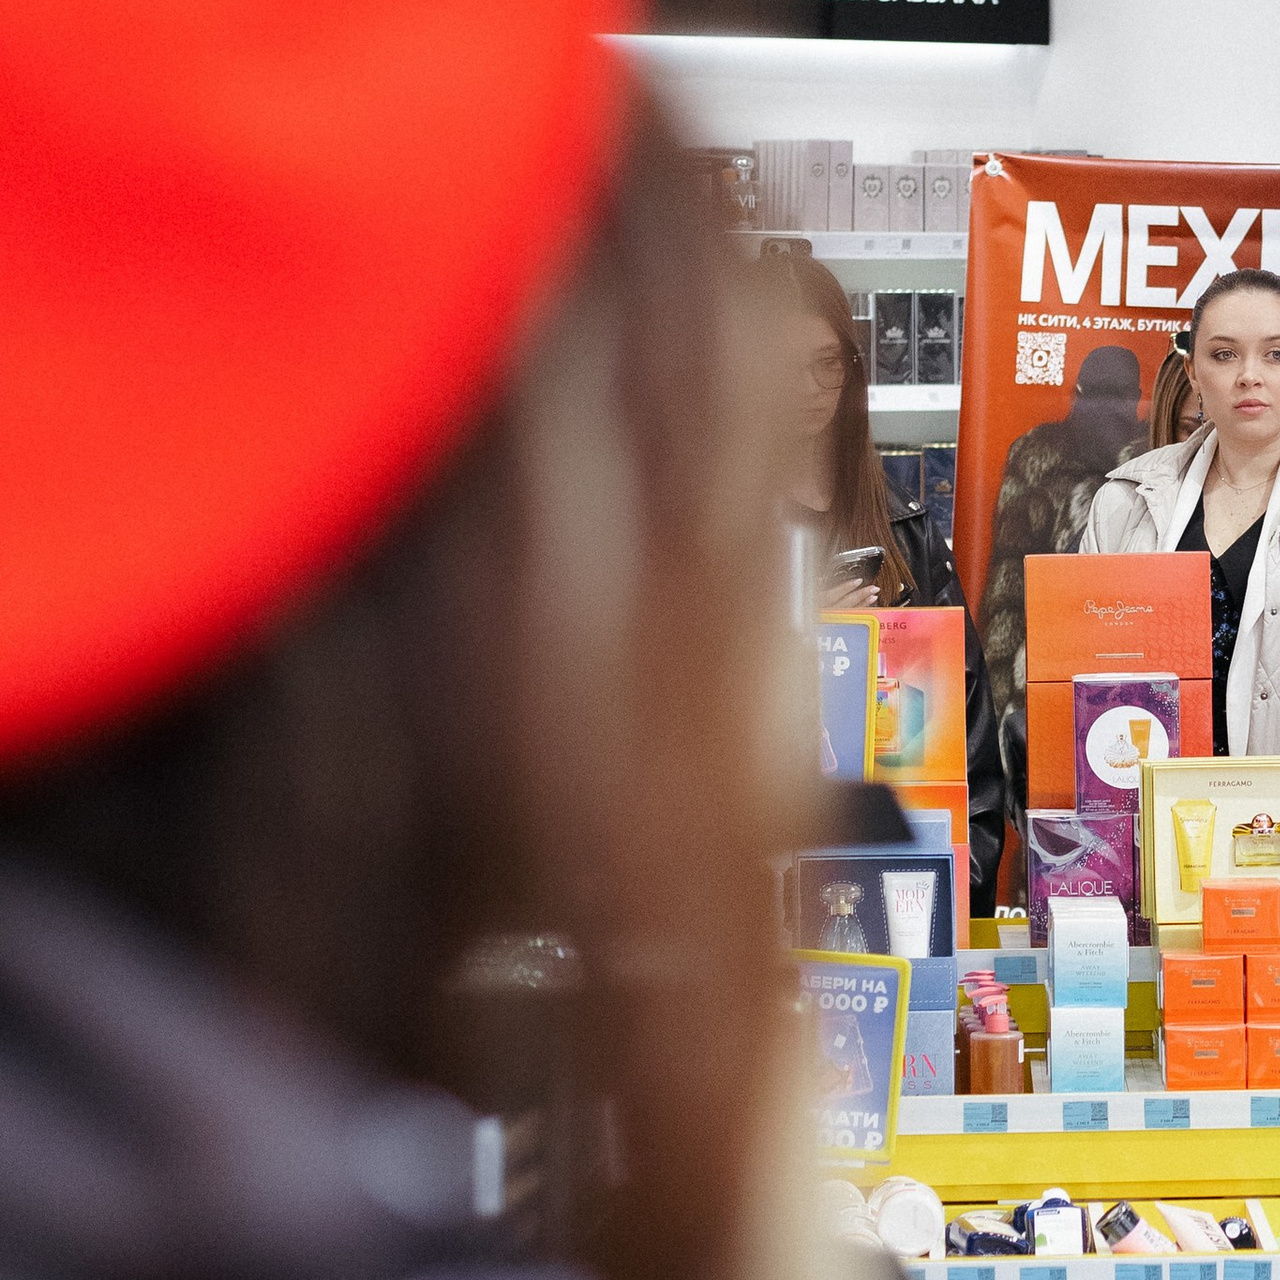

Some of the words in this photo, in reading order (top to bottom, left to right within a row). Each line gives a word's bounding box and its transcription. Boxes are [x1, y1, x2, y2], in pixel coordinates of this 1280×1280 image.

[1018, 314, 1037, 326] НК
[1038, 314, 1080, 329] СИТИ,
[1082, 317, 1091, 328] 4
[1093, 317, 1134, 331] ЭТАЖ,
[1137, 319, 1181, 332] БУТИК
[1083, 599, 1115, 620] Pepe
[1114, 600, 1154, 620] Jeans
[1050, 880, 1113, 897] LALIQUE
[862, 979, 887, 994] НА
[1065, 1030, 1112, 1038] Abercrombie
[1082, 1038, 1101, 1046] Fitch
[827, 1109, 880, 1129] АТИ
